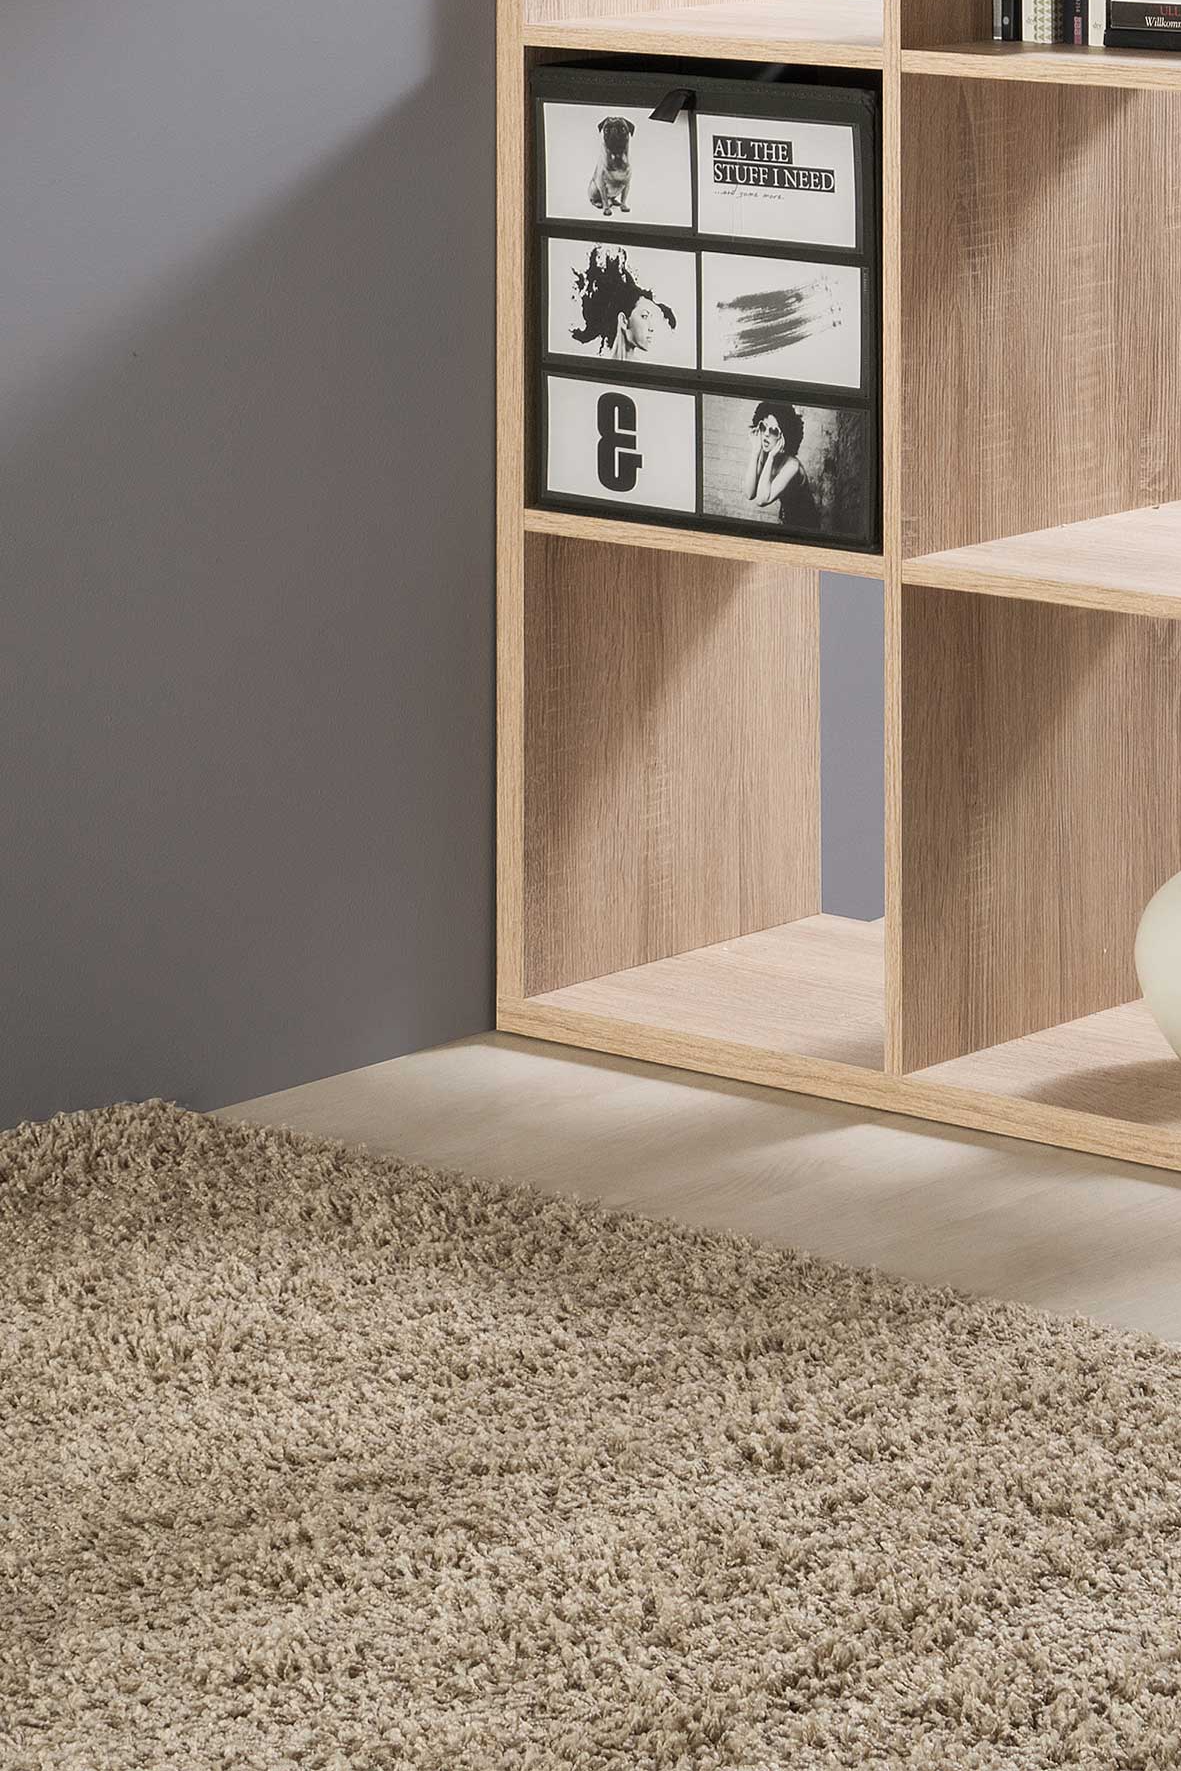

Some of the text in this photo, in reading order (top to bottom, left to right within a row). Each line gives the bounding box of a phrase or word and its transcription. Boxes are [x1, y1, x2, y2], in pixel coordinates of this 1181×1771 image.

[714, 139, 789, 162] ALL THE
[714, 163, 834, 191] STUFF I NEED
